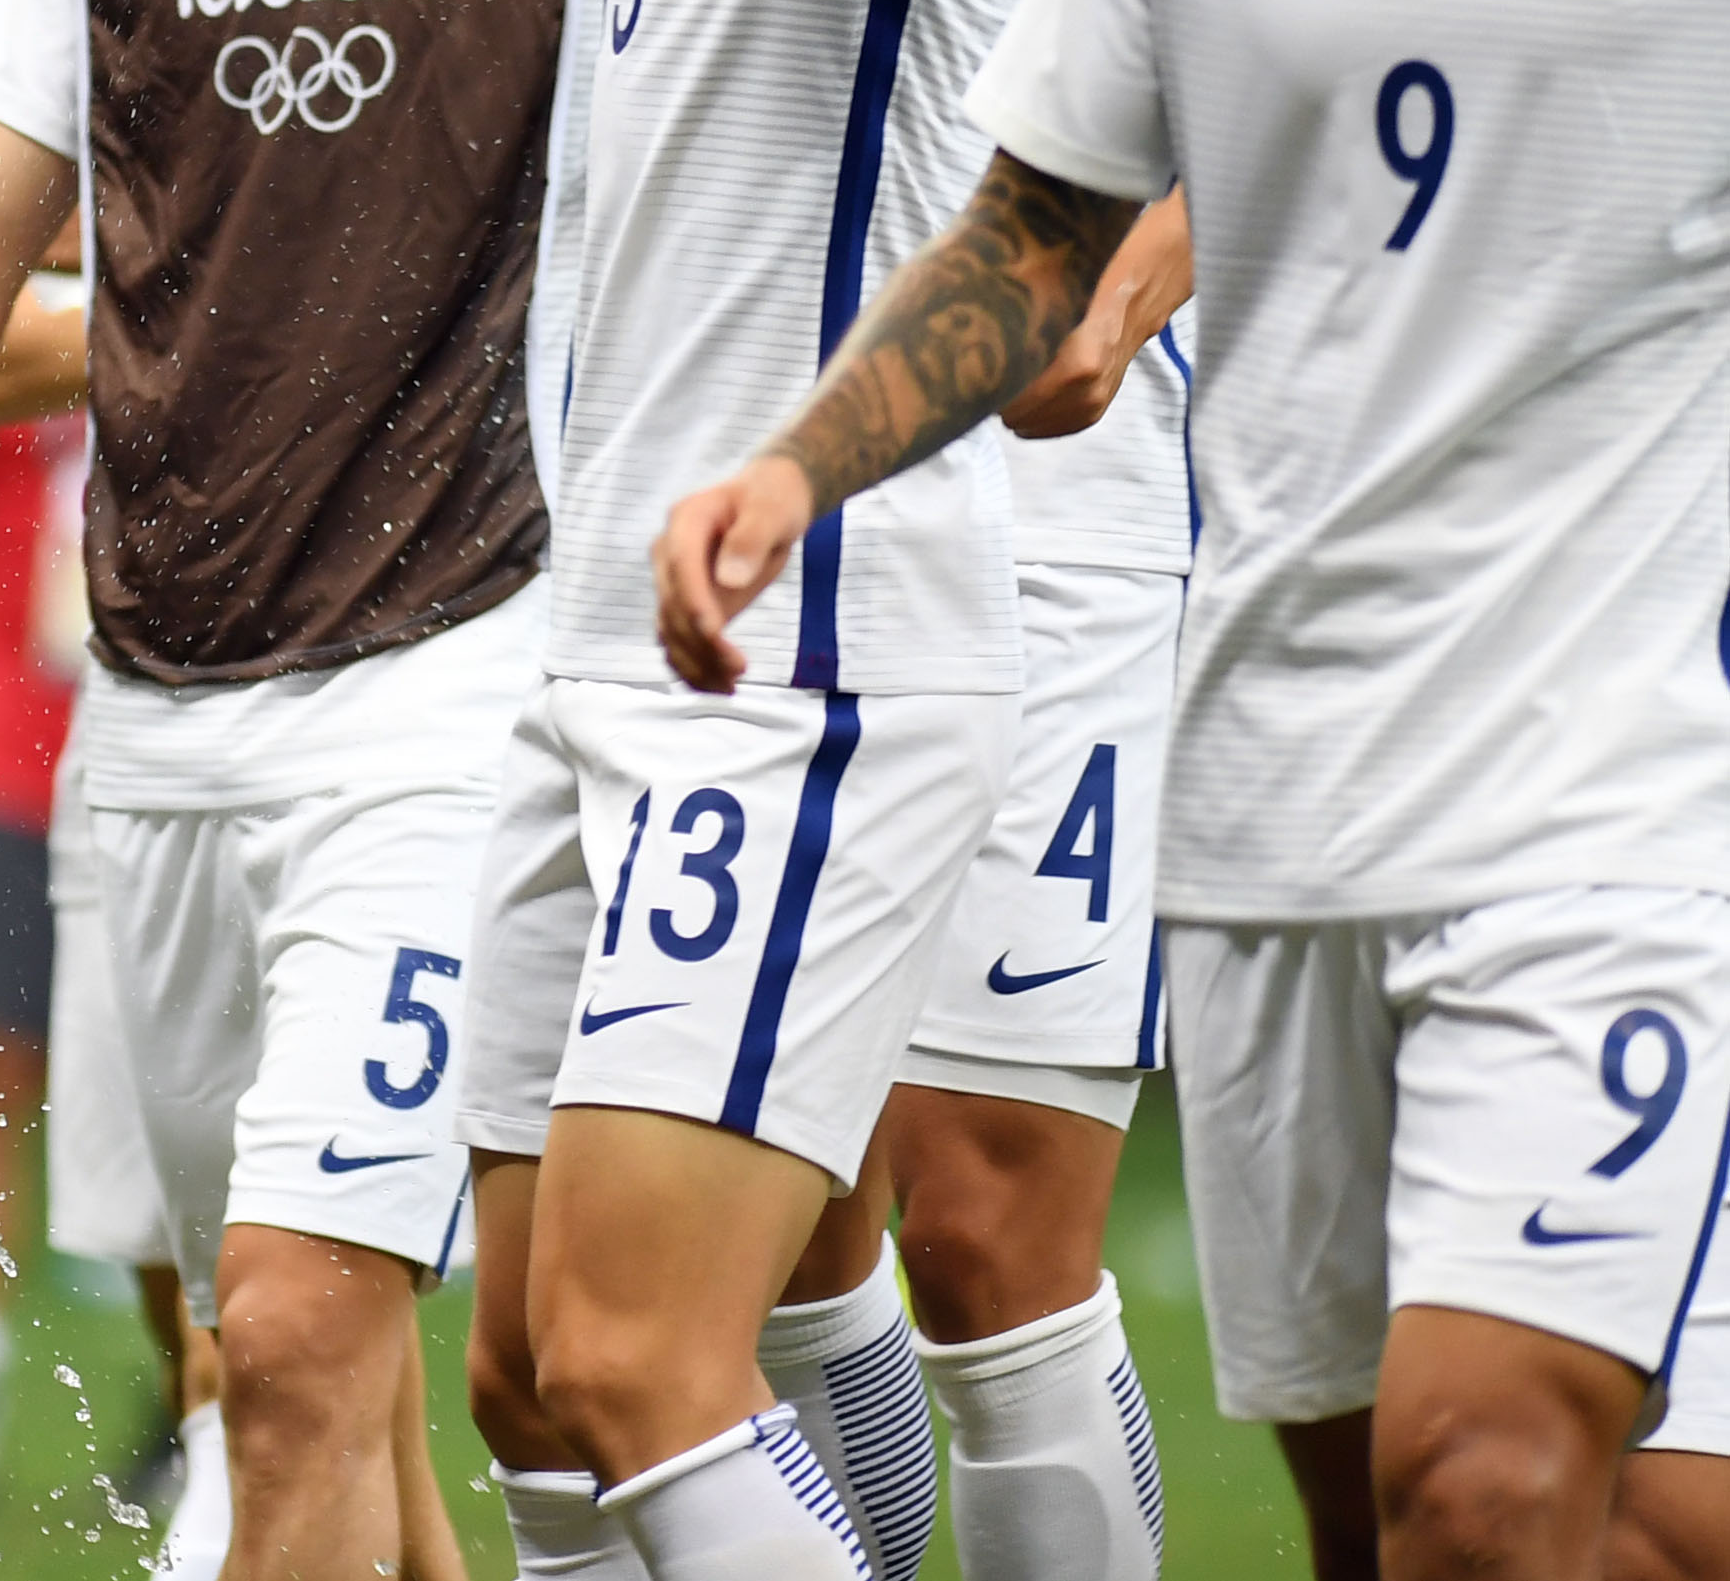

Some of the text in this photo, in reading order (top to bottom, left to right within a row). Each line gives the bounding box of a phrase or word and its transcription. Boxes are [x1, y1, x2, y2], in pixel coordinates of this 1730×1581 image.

[1376, 60, 1456, 253] 9
[602, 787, 745, 962] 13
[1036, 743, 1117, 923] 4
[364, 947, 461, 1110] 5
[1588, 1008, 1688, 1180] 9
